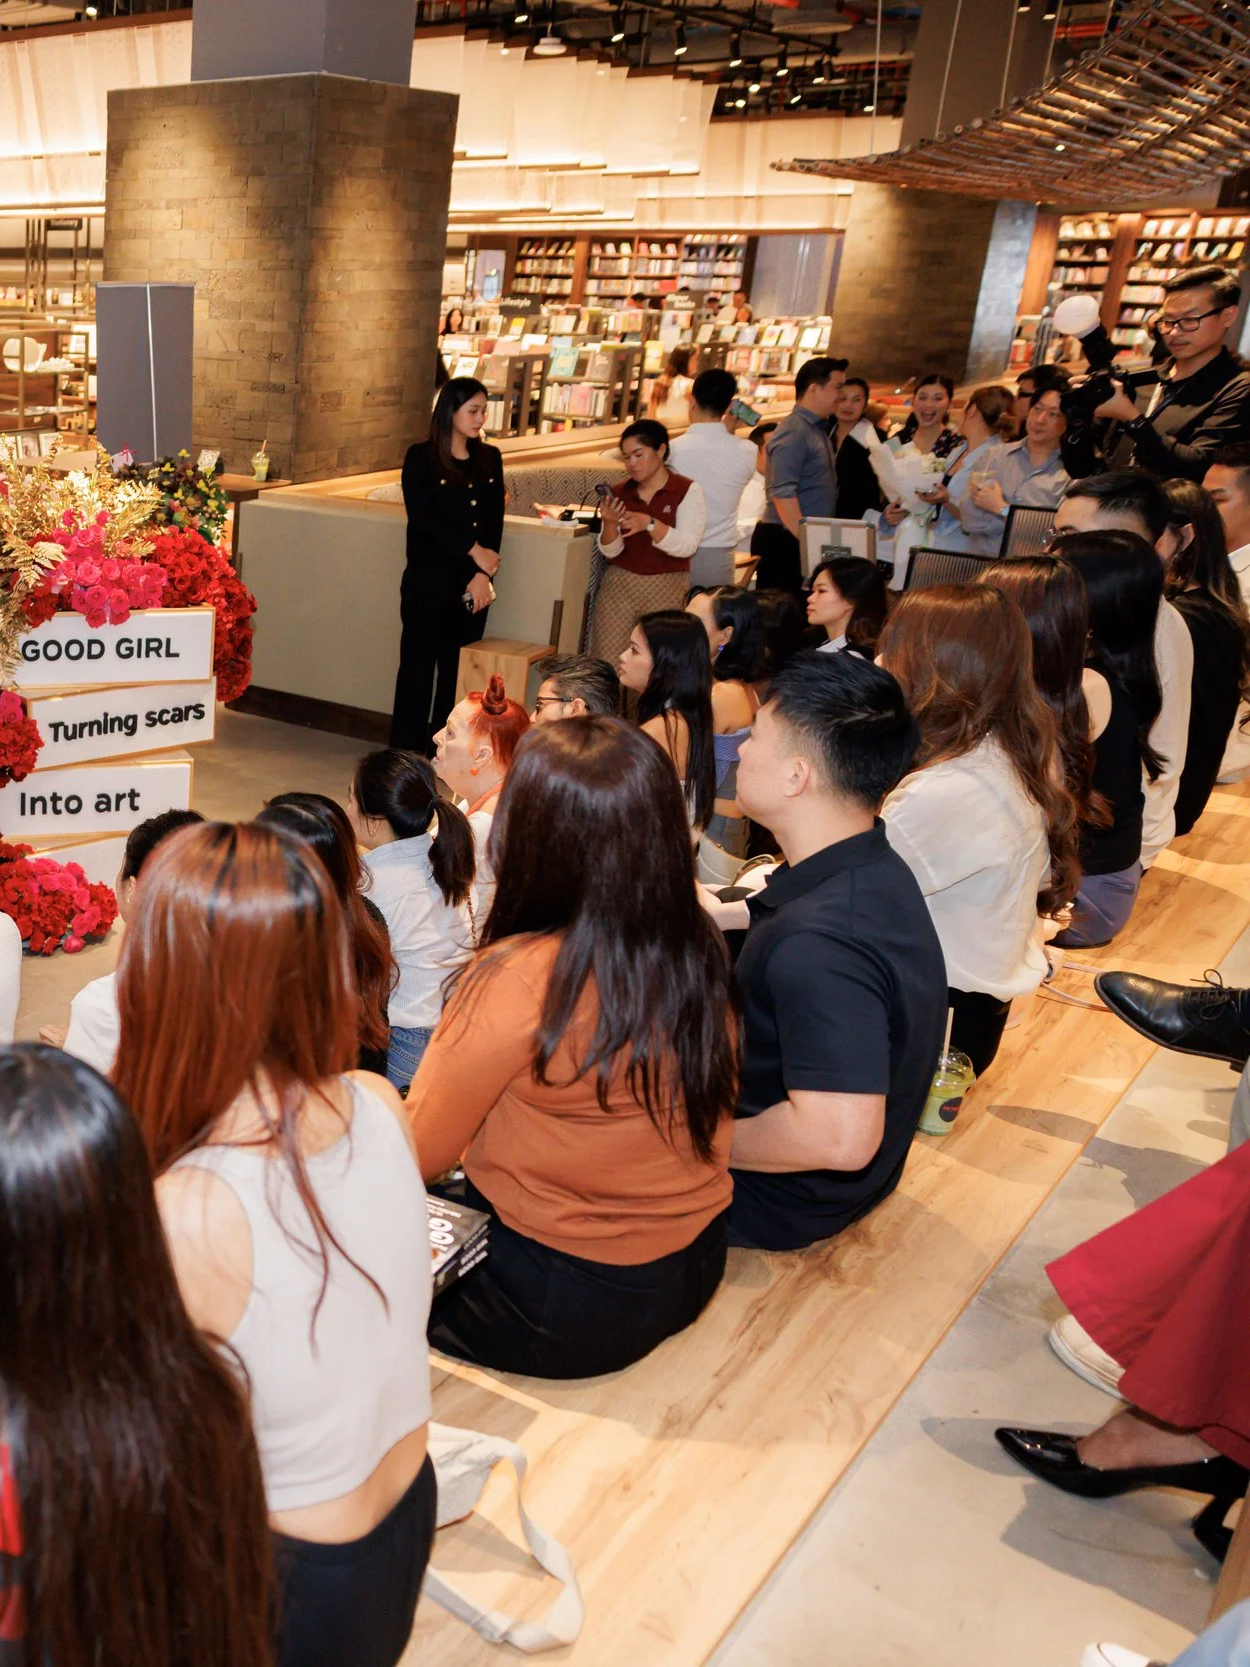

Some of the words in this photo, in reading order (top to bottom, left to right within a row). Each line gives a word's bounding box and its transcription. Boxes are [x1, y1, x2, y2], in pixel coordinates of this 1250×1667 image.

[21, 638, 106, 662] GOOD
[115, 637, 180, 660] GIRL
[48, 711, 138, 743] Turning
[145, 703, 205, 728] scars
[19, 790, 83, 817] Into
[94, 787, 141, 814] art
